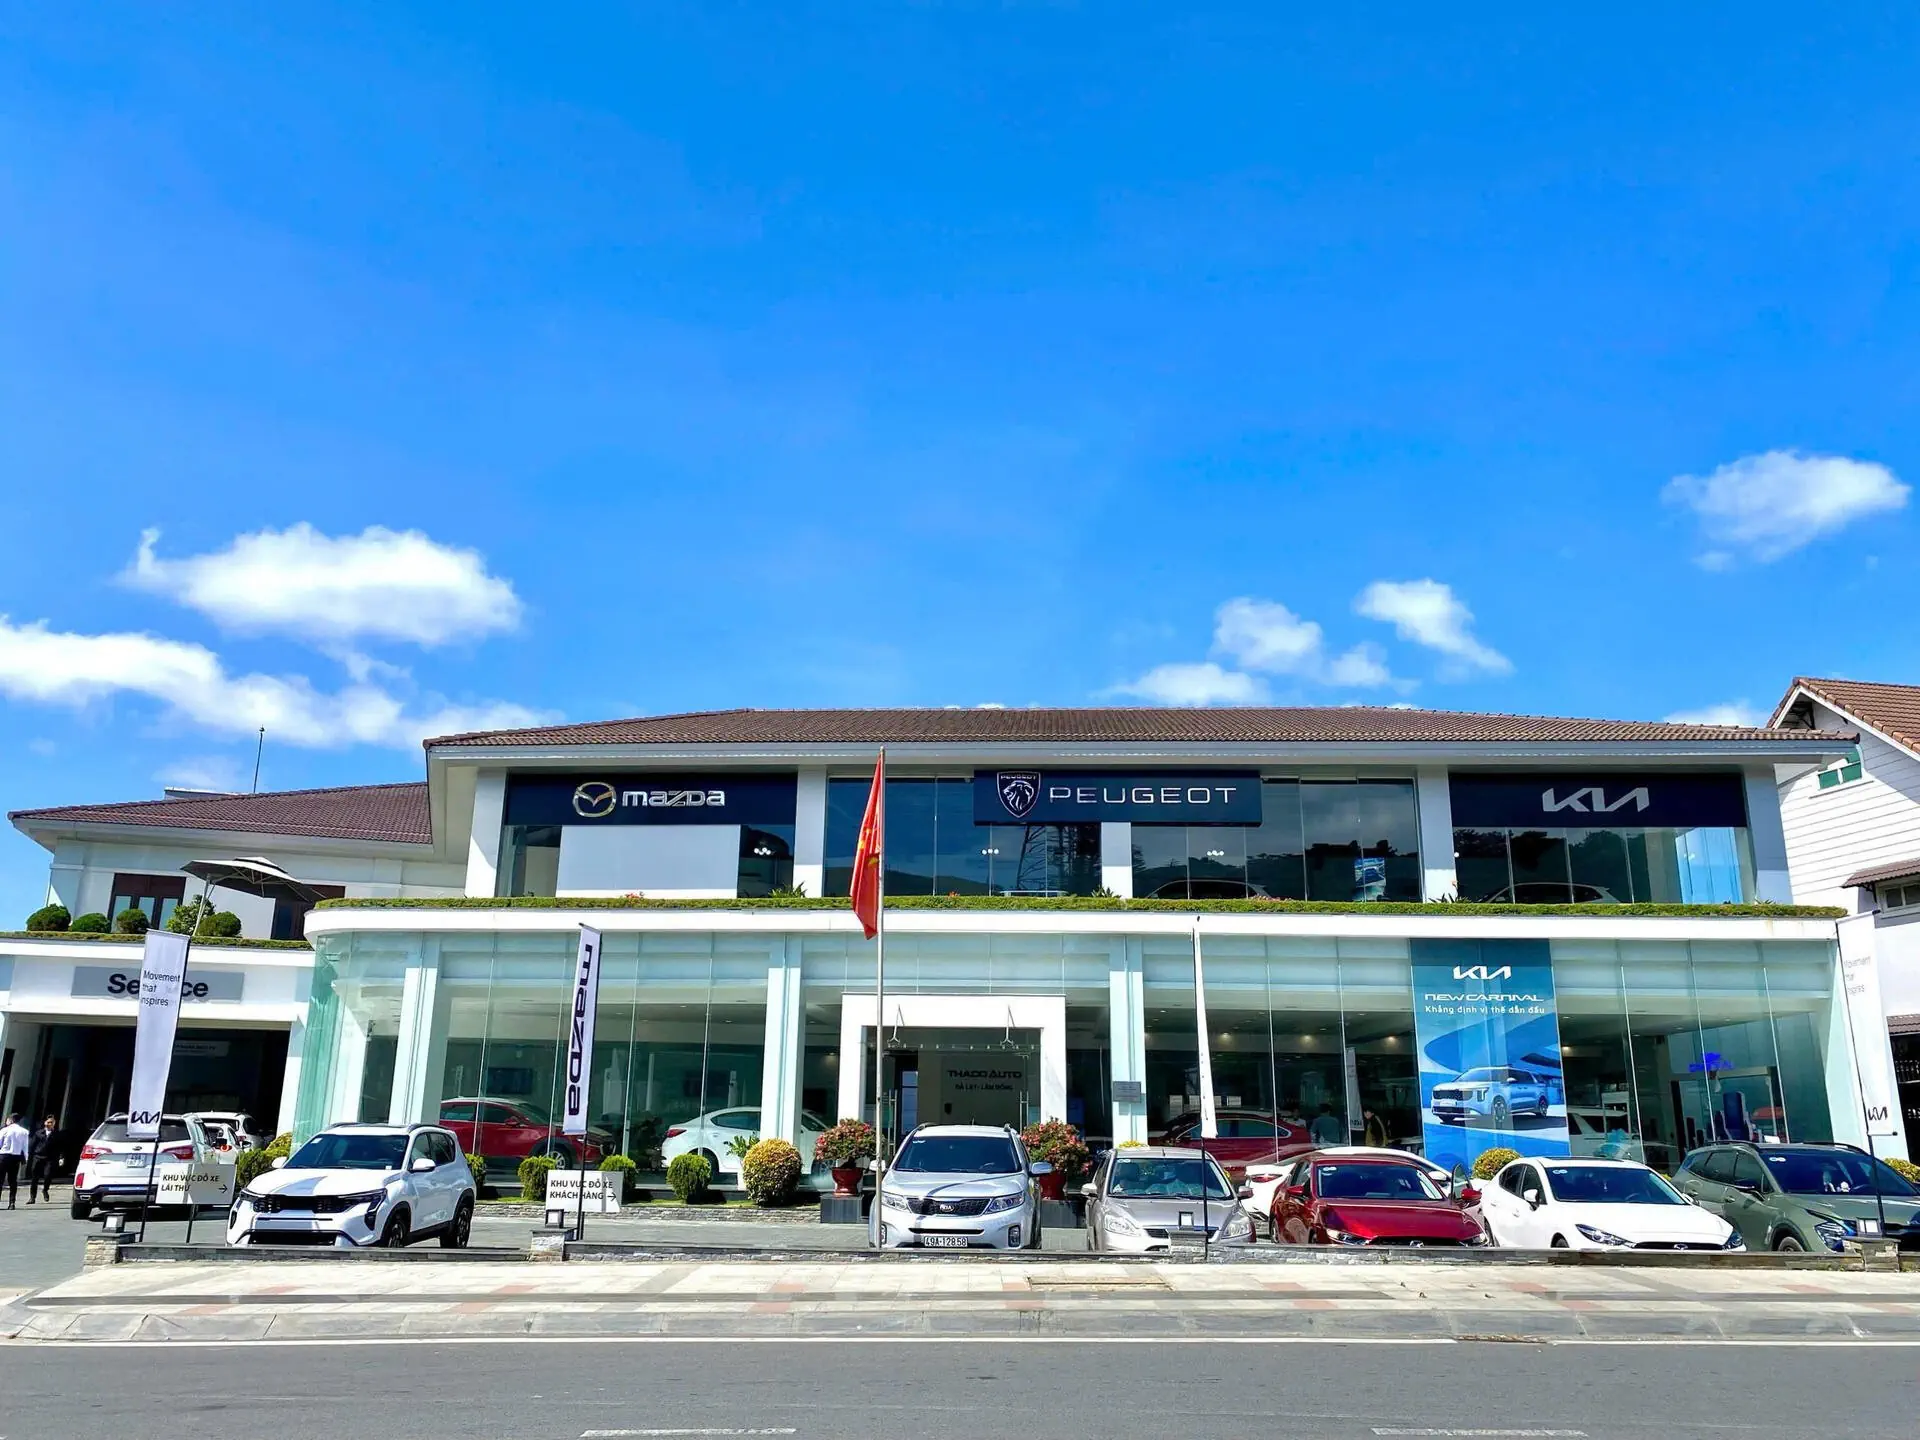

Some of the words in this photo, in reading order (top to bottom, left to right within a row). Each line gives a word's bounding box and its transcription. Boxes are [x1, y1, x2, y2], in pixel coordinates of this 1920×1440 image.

[1050, 787, 1236, 803] PEUGEOT
[1542, 787, 1649, 812] KIA
[143, 970, 181, 982] Movement
[1453, 965, 1511, 980] KIA
[107, 973, 209, 998] Sece
[141, 997, 169, 1006] nspires
[1425, 993, 1464, 1001] NEW
[1466, 994, 1544, 1002] CARNIVAL
[131, 1111, 160, 1124] KIA
[550, 1190, 578, 1198] KHÁCH
[582, 1191, 603, 1199] HÀNG
